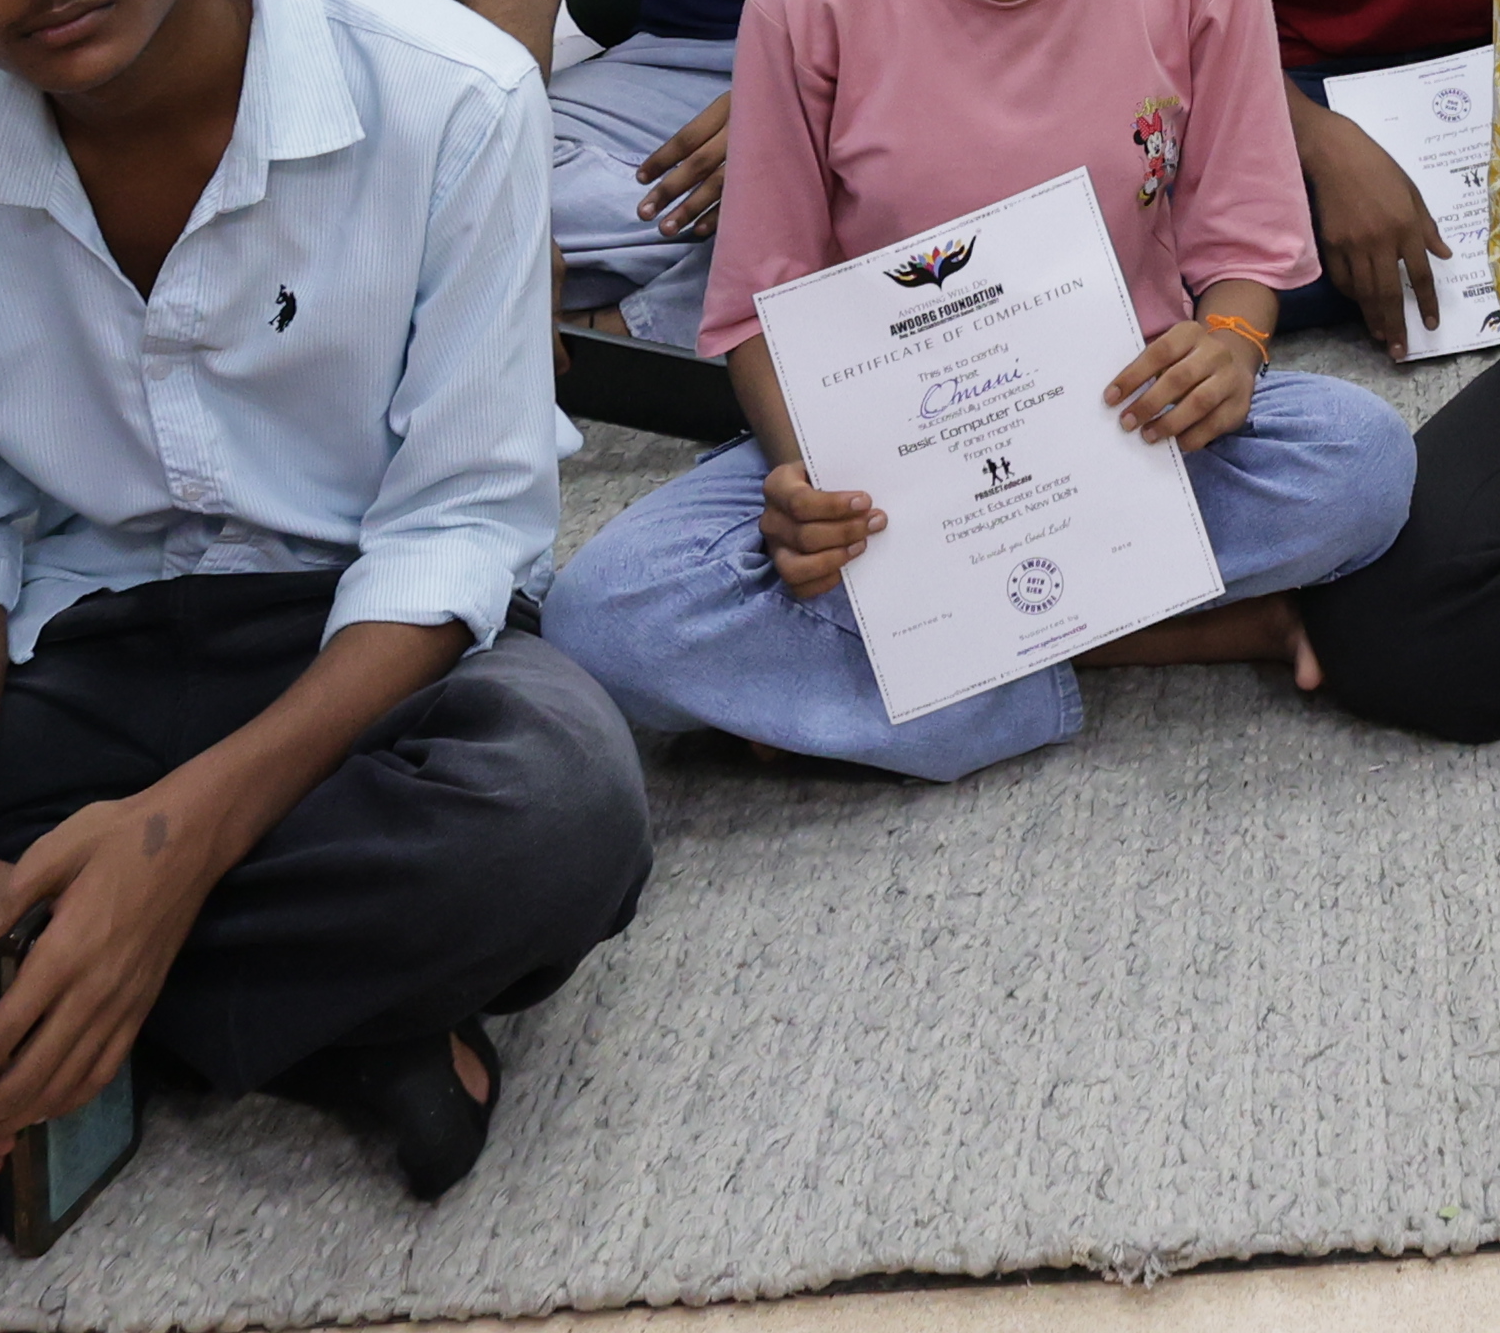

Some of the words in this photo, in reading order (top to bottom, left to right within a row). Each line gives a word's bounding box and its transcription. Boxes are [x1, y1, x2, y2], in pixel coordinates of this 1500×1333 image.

[822, 339, 935, 387] CERTIFICATE
[942, 327, 964, 343] OF
[973, 278, 1084, 331] COMPLETION
[890, 308, 937, 336] AWDORG
[939, 283, 1004, 319] FOUNDATION
[898, 433, 938, 457] Basic
[940, 407, 1010, 441] Computer
[1014, 385, 1064, 413] Course
